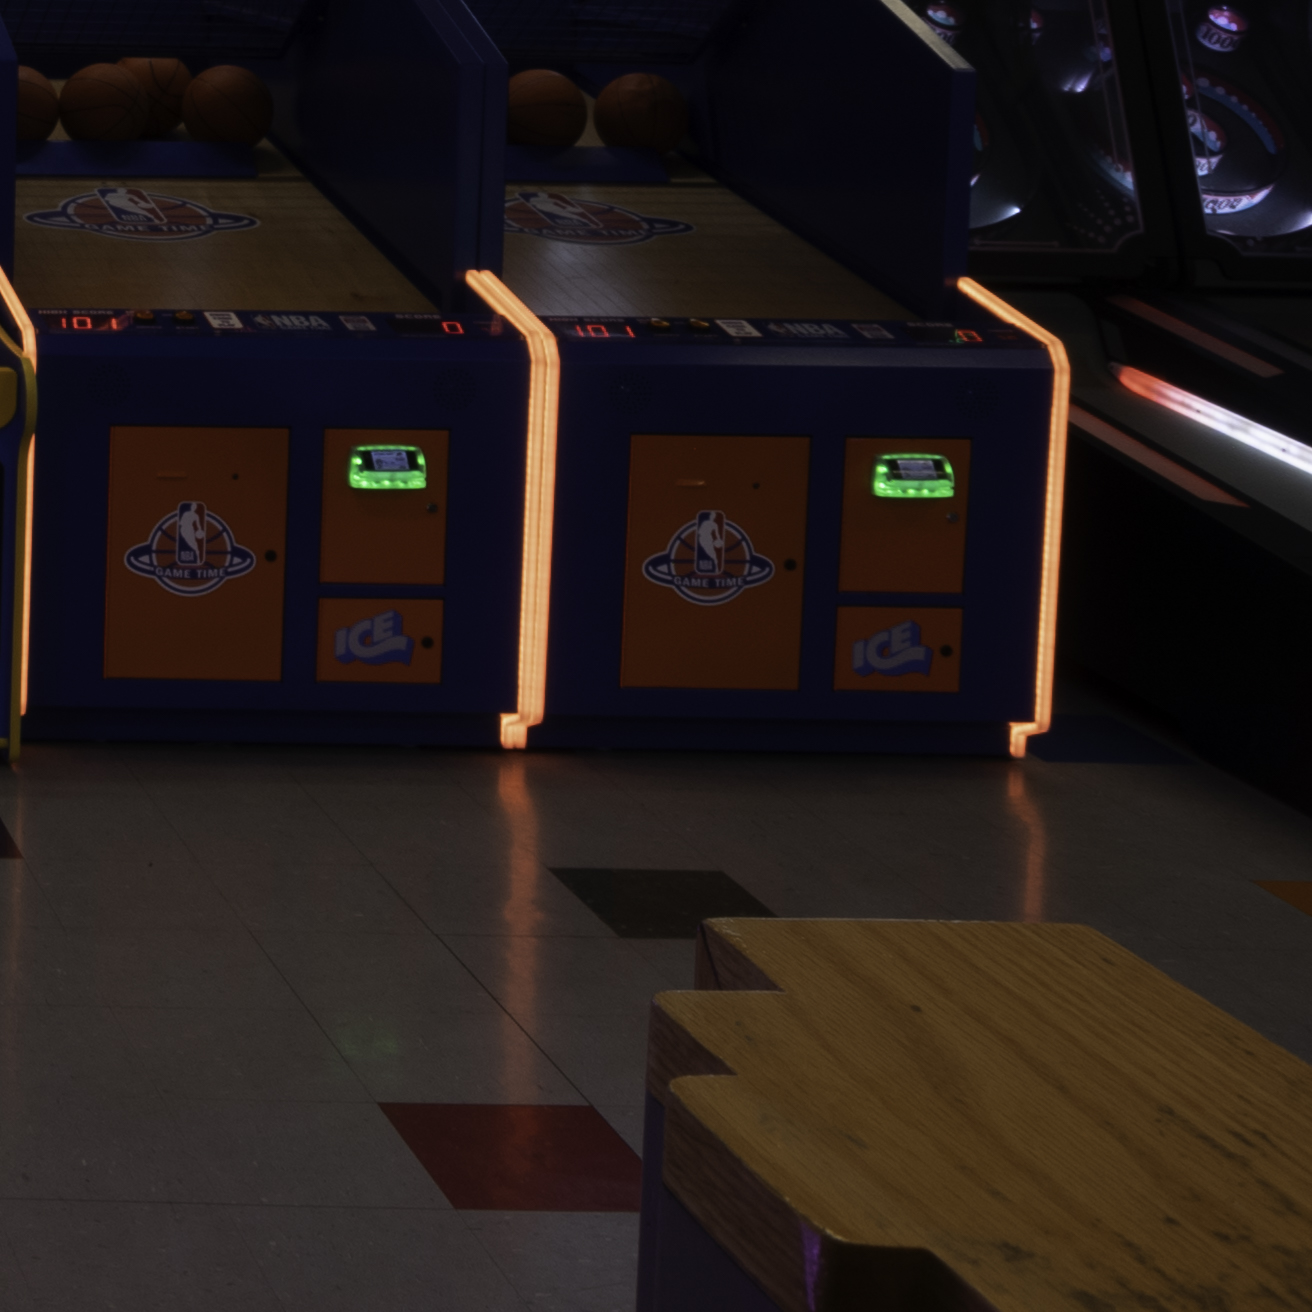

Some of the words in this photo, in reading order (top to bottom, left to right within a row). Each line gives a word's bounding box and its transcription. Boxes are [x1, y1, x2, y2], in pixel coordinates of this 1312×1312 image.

[84, 223, 151, 232] GAME
[159, 223, 212, 232] TIME
[271, 314, 329, 328] NBA
[786, 322, 844, 335] NBA
[155, 566, 192, 579] GAME
[196, 566, 227, 579] TIME
[674, 575, 710, 589] GAME
[714, 575, 745, 588] TIME
[335, 609, 415, 667] ICE
[852, 620, 933, 677] ICE
